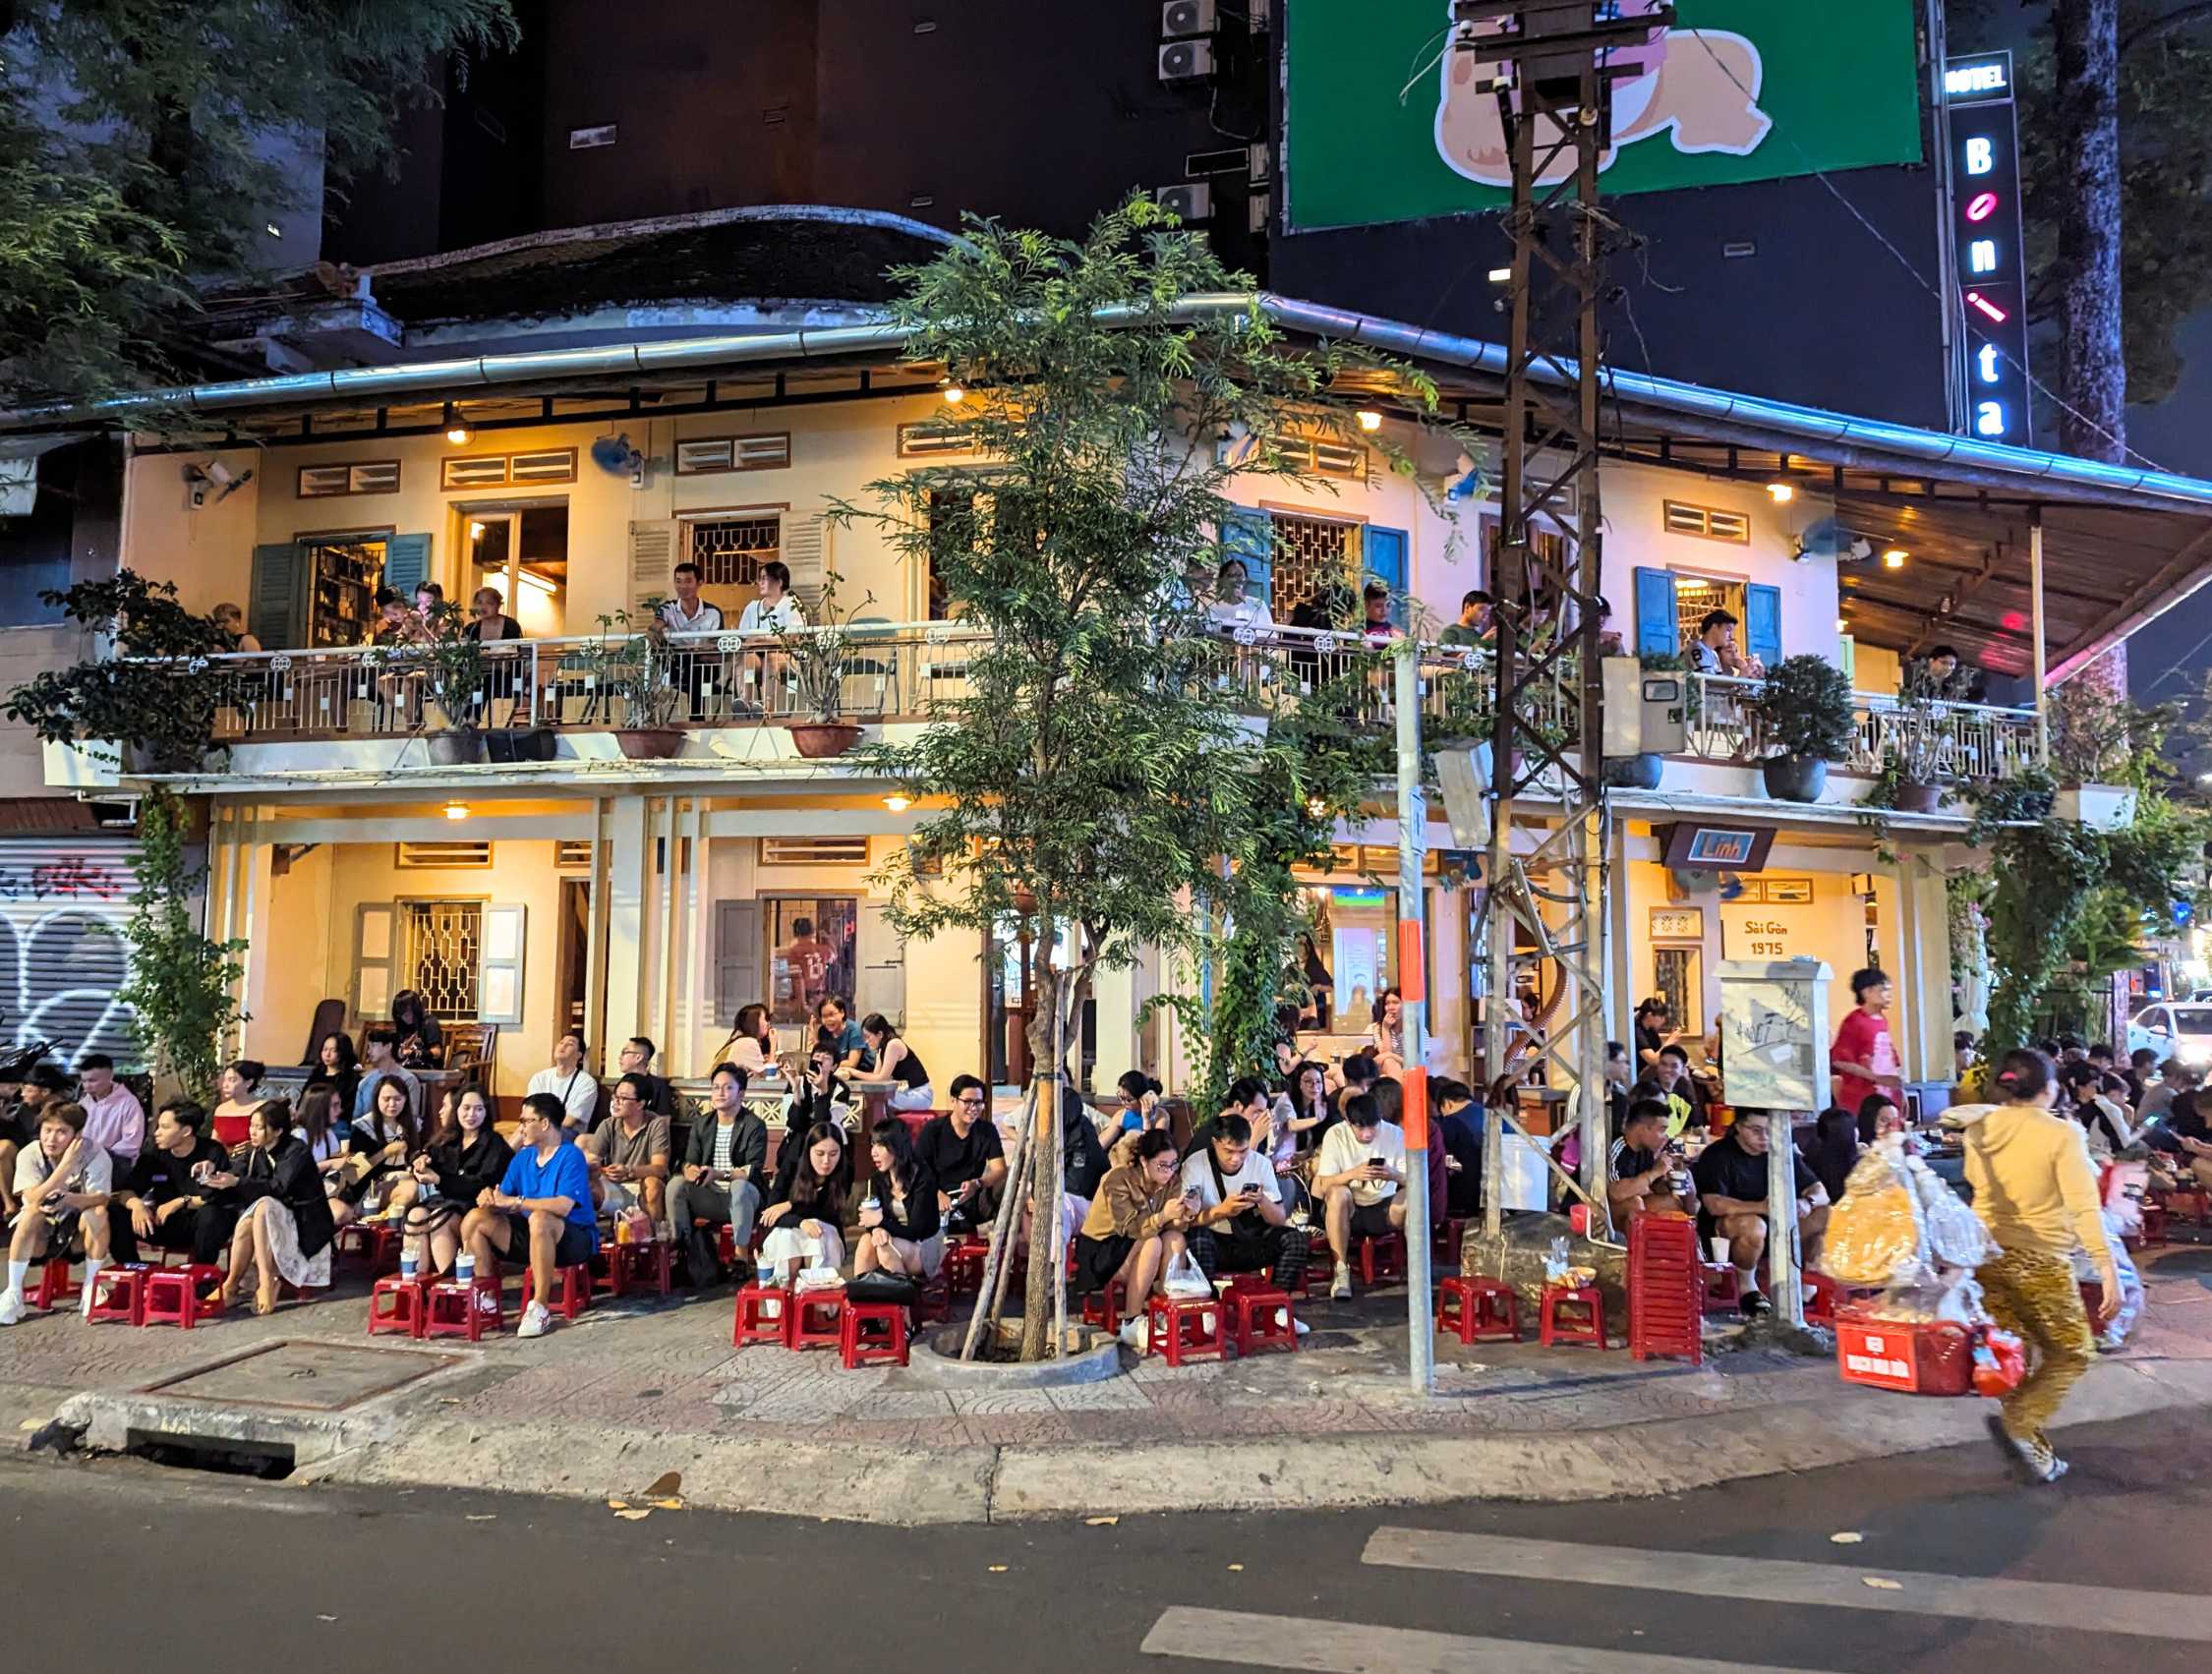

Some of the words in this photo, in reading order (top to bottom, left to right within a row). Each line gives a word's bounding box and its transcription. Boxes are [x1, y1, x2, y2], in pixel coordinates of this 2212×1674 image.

[1946, 65, 2008, 93] HOTEL
[1965, 138, 2007, 435] Bonita
[1745, 920, 1763, 934] Sài
[1767, 921, 1787, 935] Gòn
[1751, 942, 1782, 954] 1975
